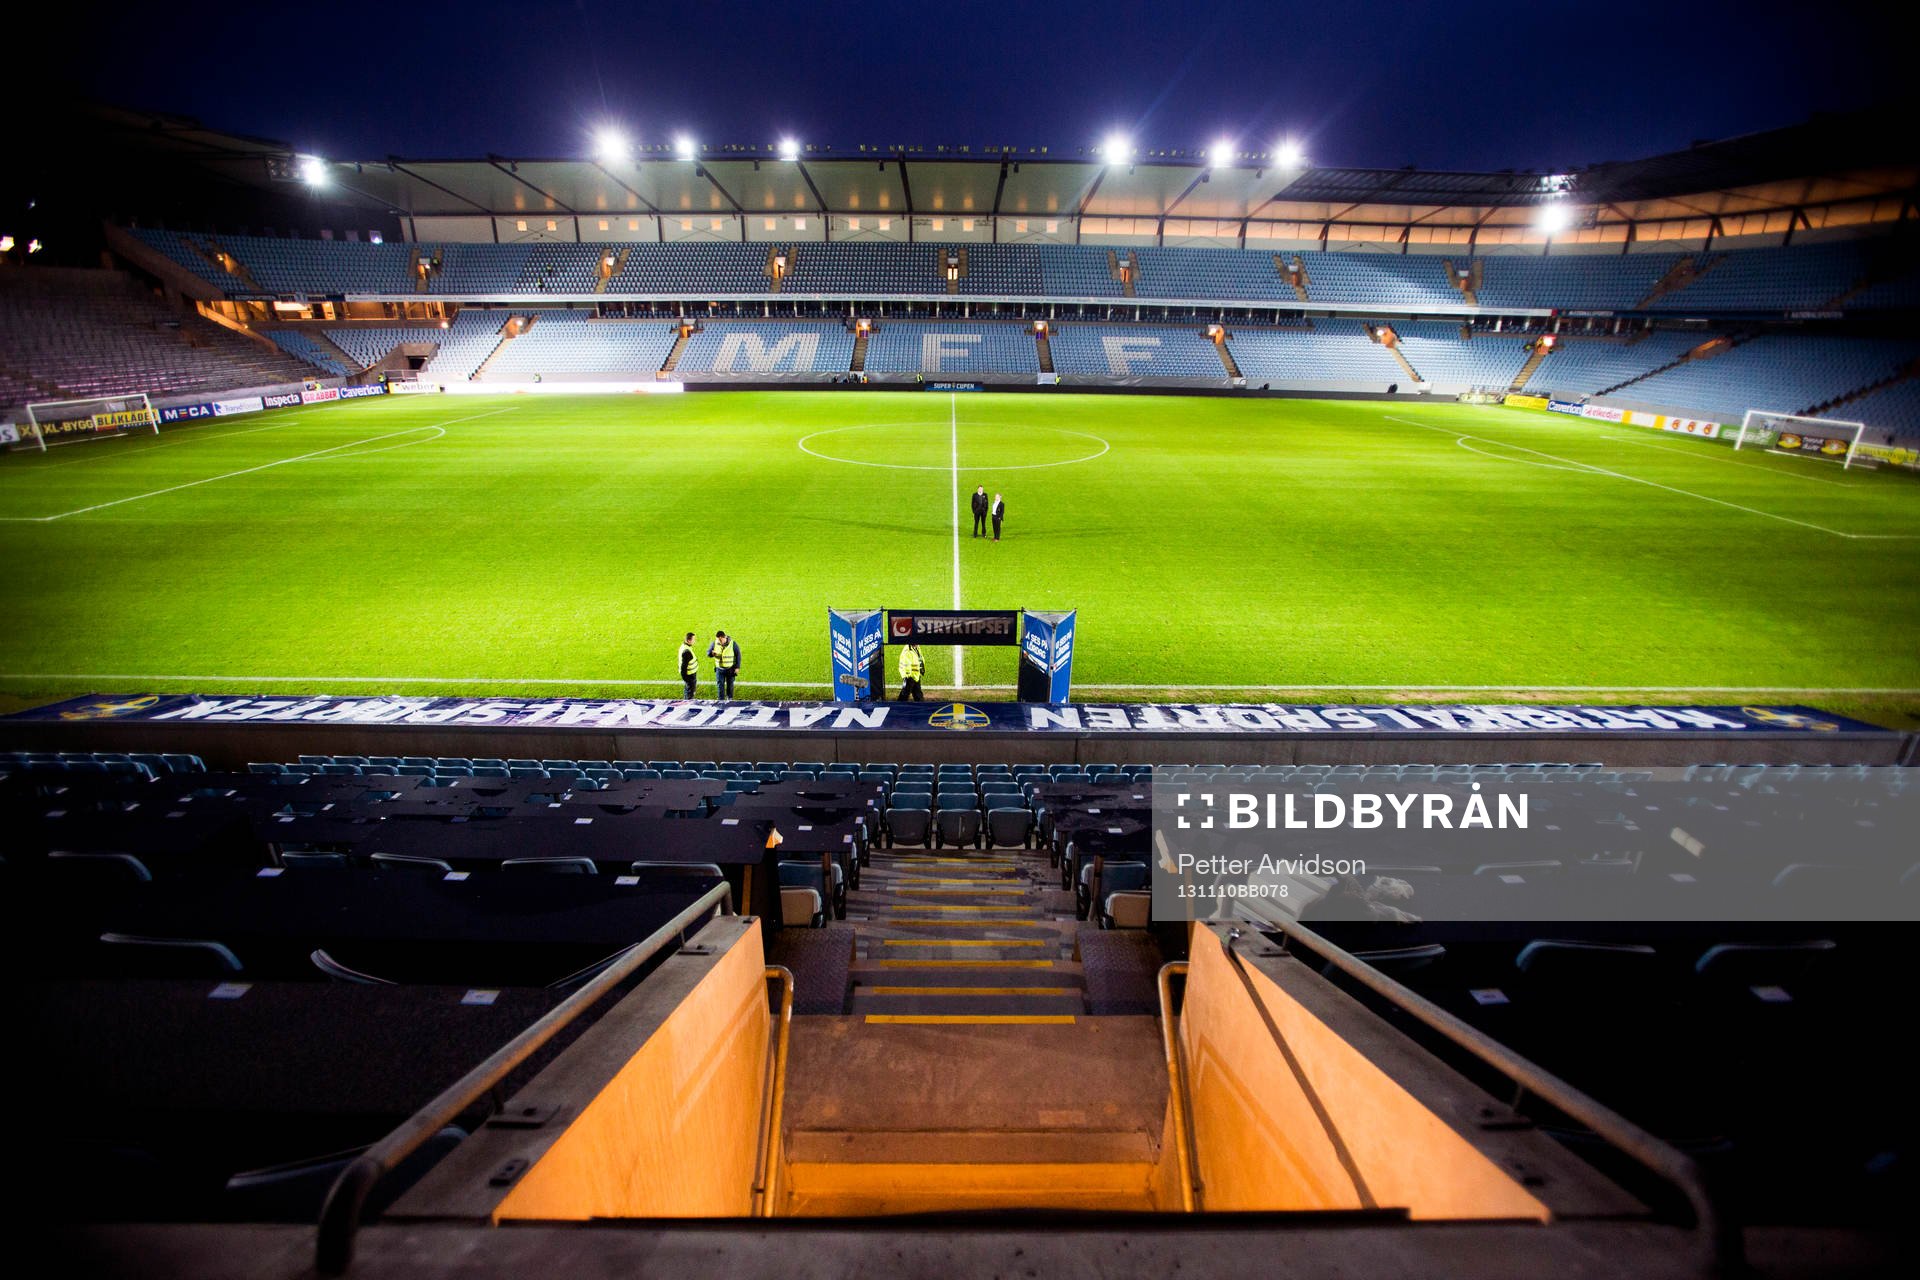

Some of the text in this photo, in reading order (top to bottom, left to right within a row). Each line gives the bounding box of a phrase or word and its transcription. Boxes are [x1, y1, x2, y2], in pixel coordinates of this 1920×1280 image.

[340, 384, 383, 398] Caverion
[401, 383, 435, 391] weber
[264, 393, 300, 407] Inspecta
[303, 388, 338, 402] GRABBER
[1549, 401, 1582, 415] Caverion
[43, 419, 94, 434] XL-BYGG
[917, 619, 1010, 634] STRYKTIPSET
[150, 698, 891, 728] NATIONALSPORTEN
[1030, 706, 1746, 729] NATIONALSPORTEN
